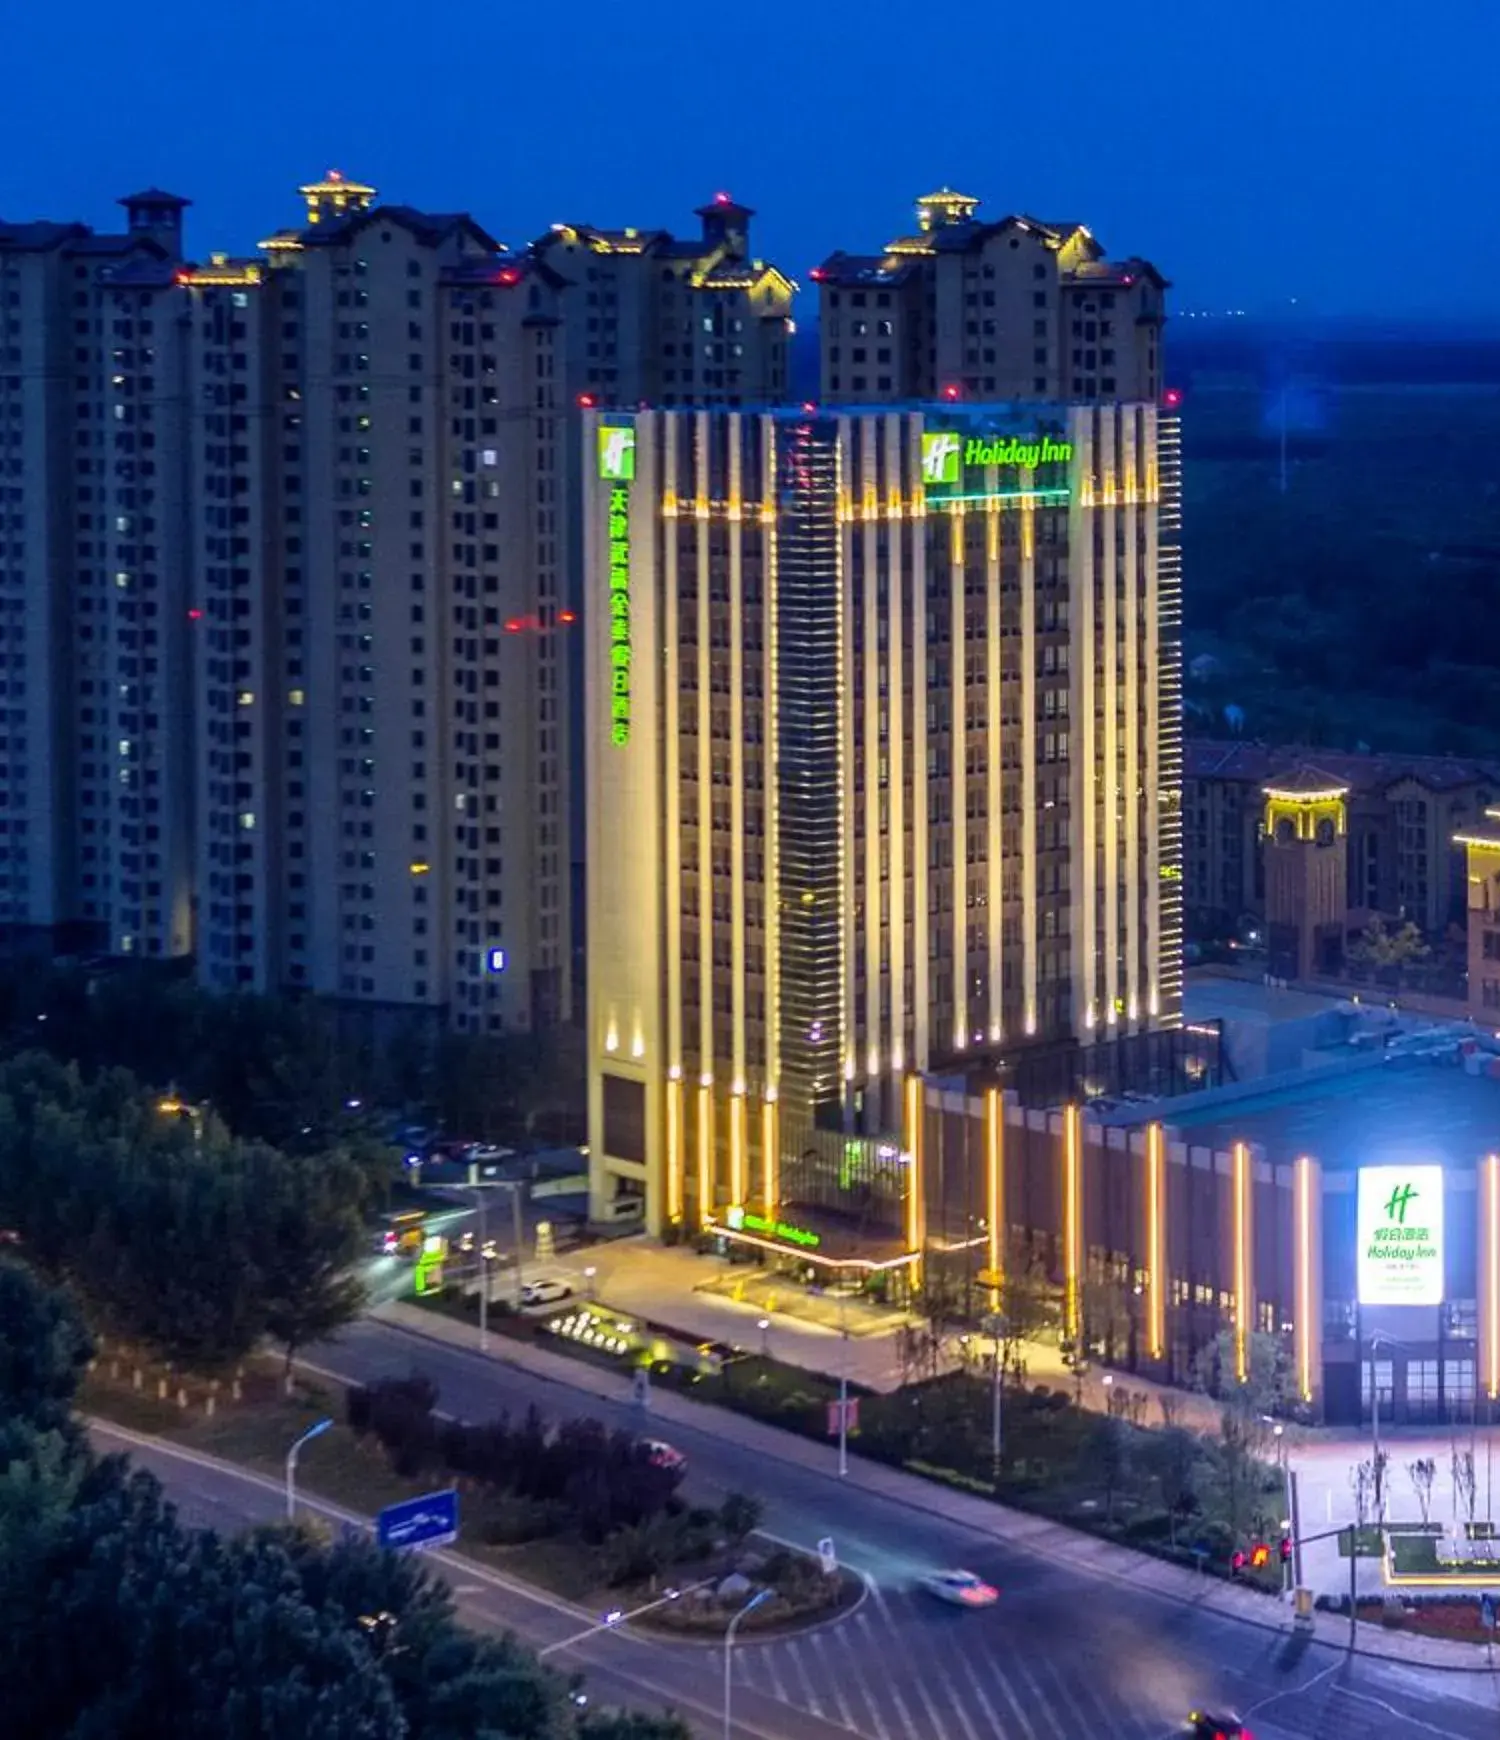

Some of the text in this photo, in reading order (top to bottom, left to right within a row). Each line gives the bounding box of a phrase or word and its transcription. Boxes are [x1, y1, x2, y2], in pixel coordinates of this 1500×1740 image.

[965, 437, 1072, 468] Holiday Inn
[1367, 1243, 1437, 1260] Holiday Inn
